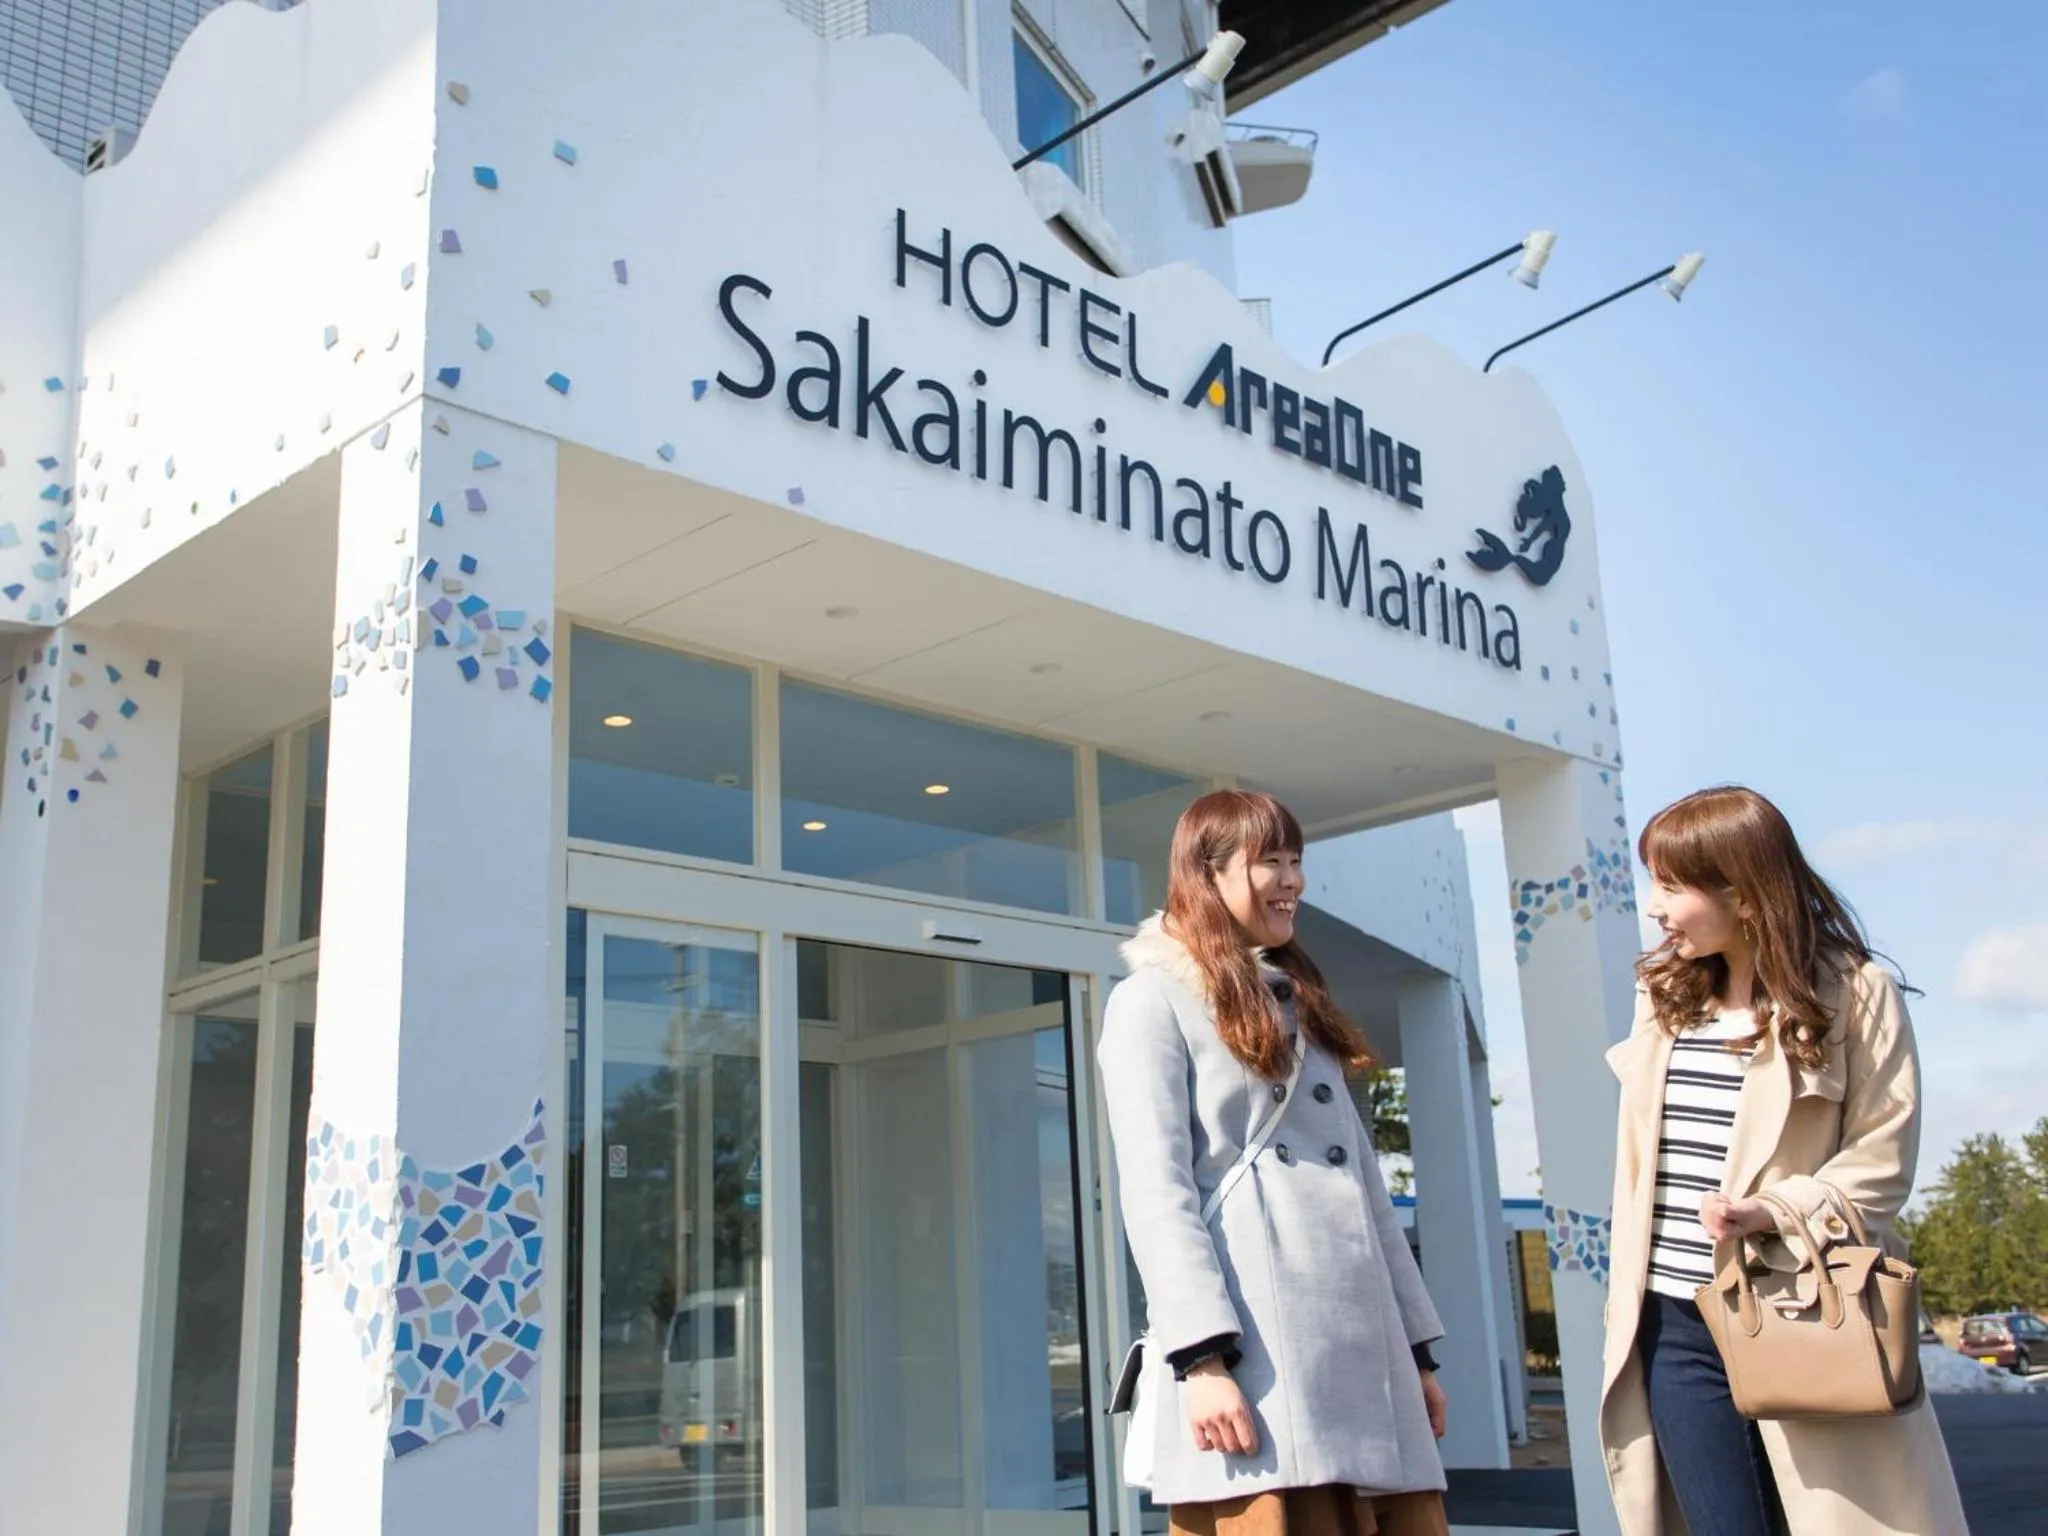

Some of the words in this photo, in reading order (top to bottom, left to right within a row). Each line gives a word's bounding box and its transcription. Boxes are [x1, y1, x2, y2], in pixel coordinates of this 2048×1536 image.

[716, 273, 1292, 585] Sakaiminato
[1317, 506, 1523, 672] Marina
[896, 208, 1169, 400] HOTEL
[1182, 342, 1424, 511] AreaOne
